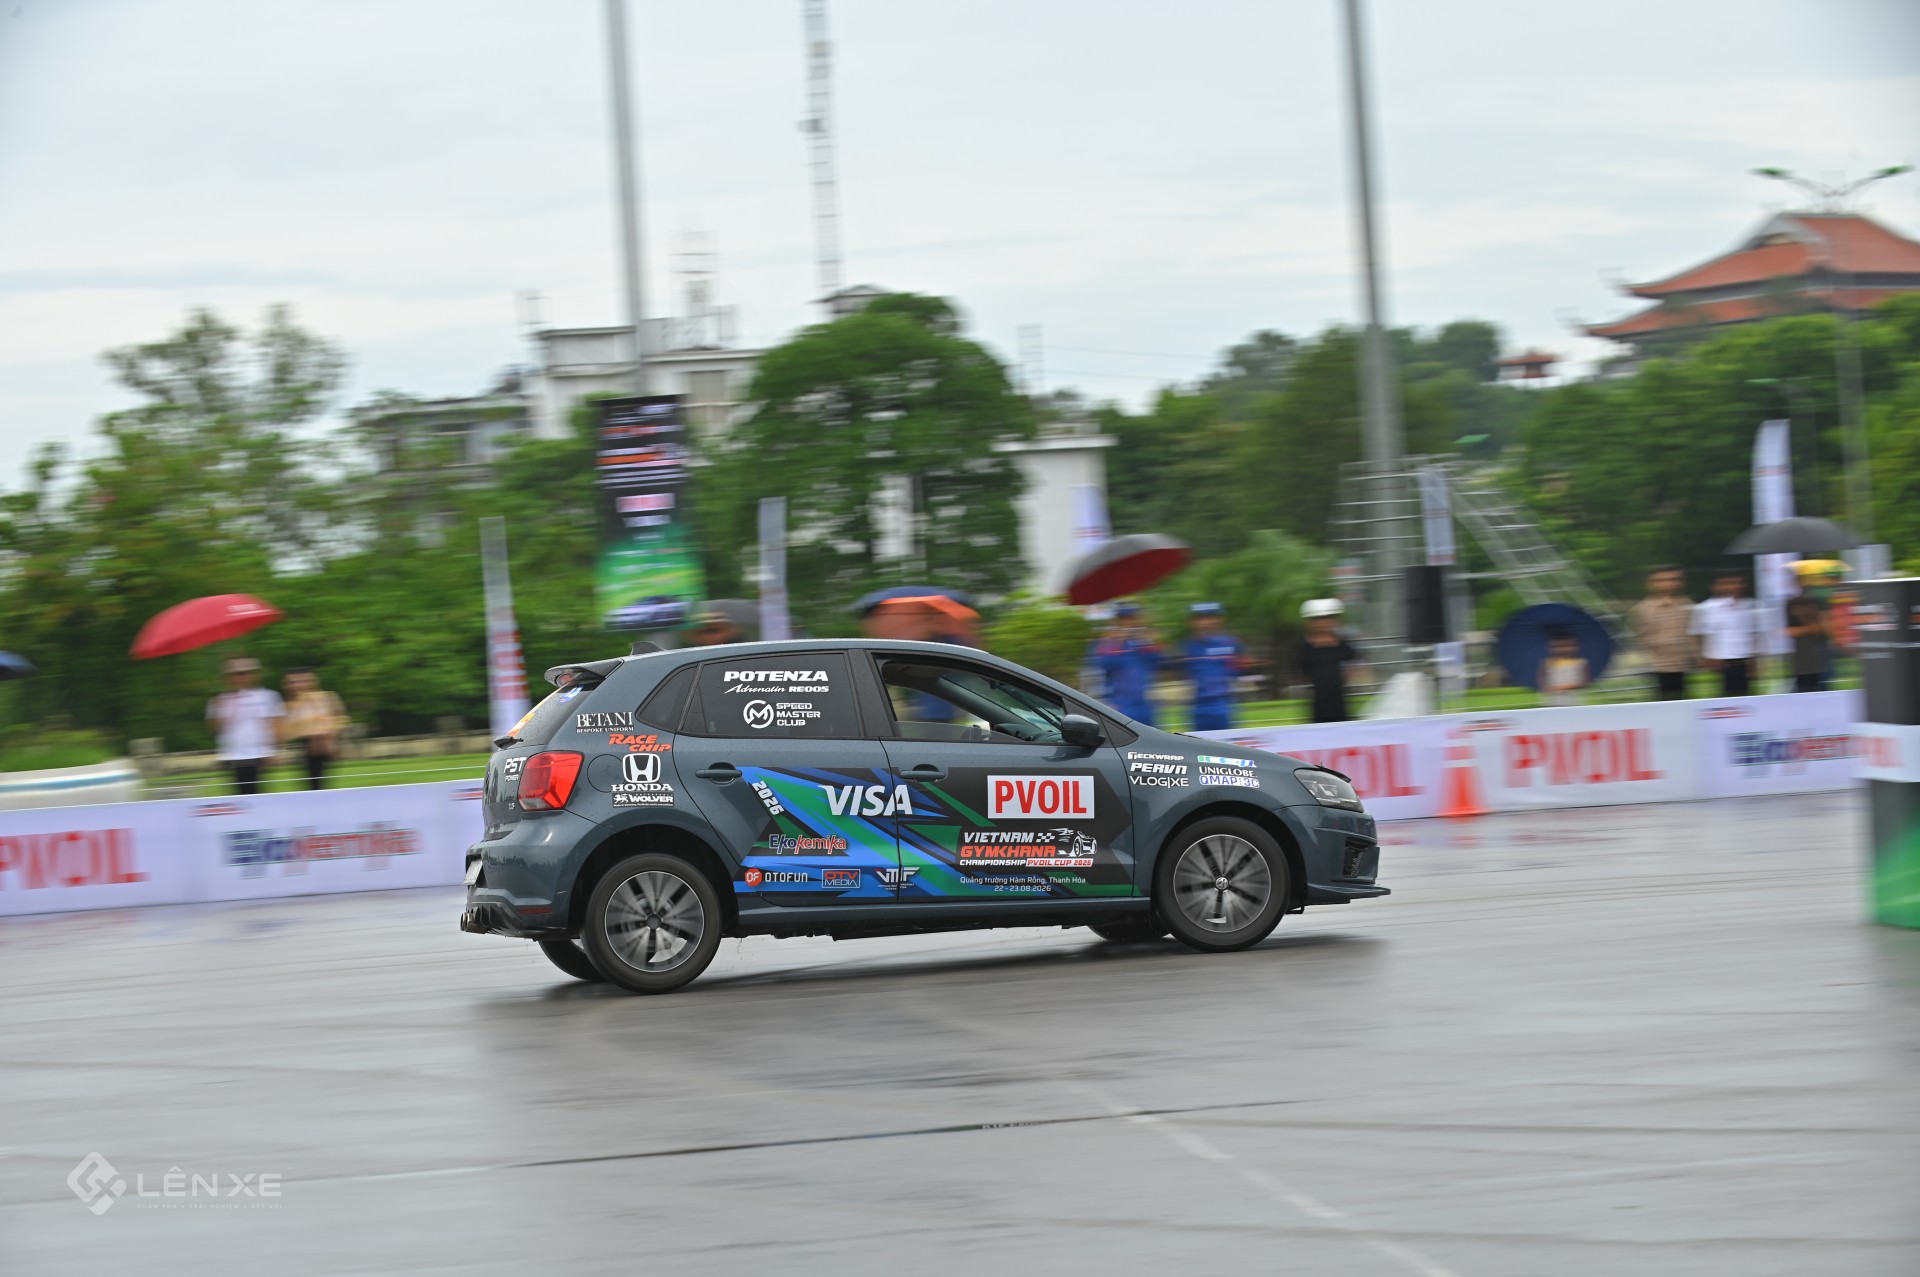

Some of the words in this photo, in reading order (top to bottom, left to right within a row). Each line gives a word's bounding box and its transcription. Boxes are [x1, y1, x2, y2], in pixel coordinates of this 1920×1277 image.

[723, 671, 829, 682] POTENZA
[723, 683, 786, 694] Adrenalin
[788, 685, 830, 693] RE005
[576, 711, 633, 727] BETANI
[608, 733, 659, 745] RACE
[628, 743, 673, 752] CHIP
[503, 757, 528, 775] PST
[611, 783, 674, 792] HONDA
[628, 794, 674, 803] WOLVER
[751, 780, 785, 816] 2026
[817, 784, 913, 816] VISA
[995, 780, 1087, 814] PVOIL
[963, 832, 1035, 843] VIETNAM
[768, 833, 847, 855] Ekokemika
[960, 845, 1057, 858] GYMKHANA
[764, 872, 808, 883] OTOFUN
[824, 871, 859, 880] OTV
[960, 876, 983, 885] Quảng
[984, 876, 1008, 885] trường
[1009, 876, 1026, 884] Hàm
[1049, 876, 1071, 884] Thanh
[1072, 876, 1086, 884] Hóa
[825, 879, 858, 887] MEDIA
